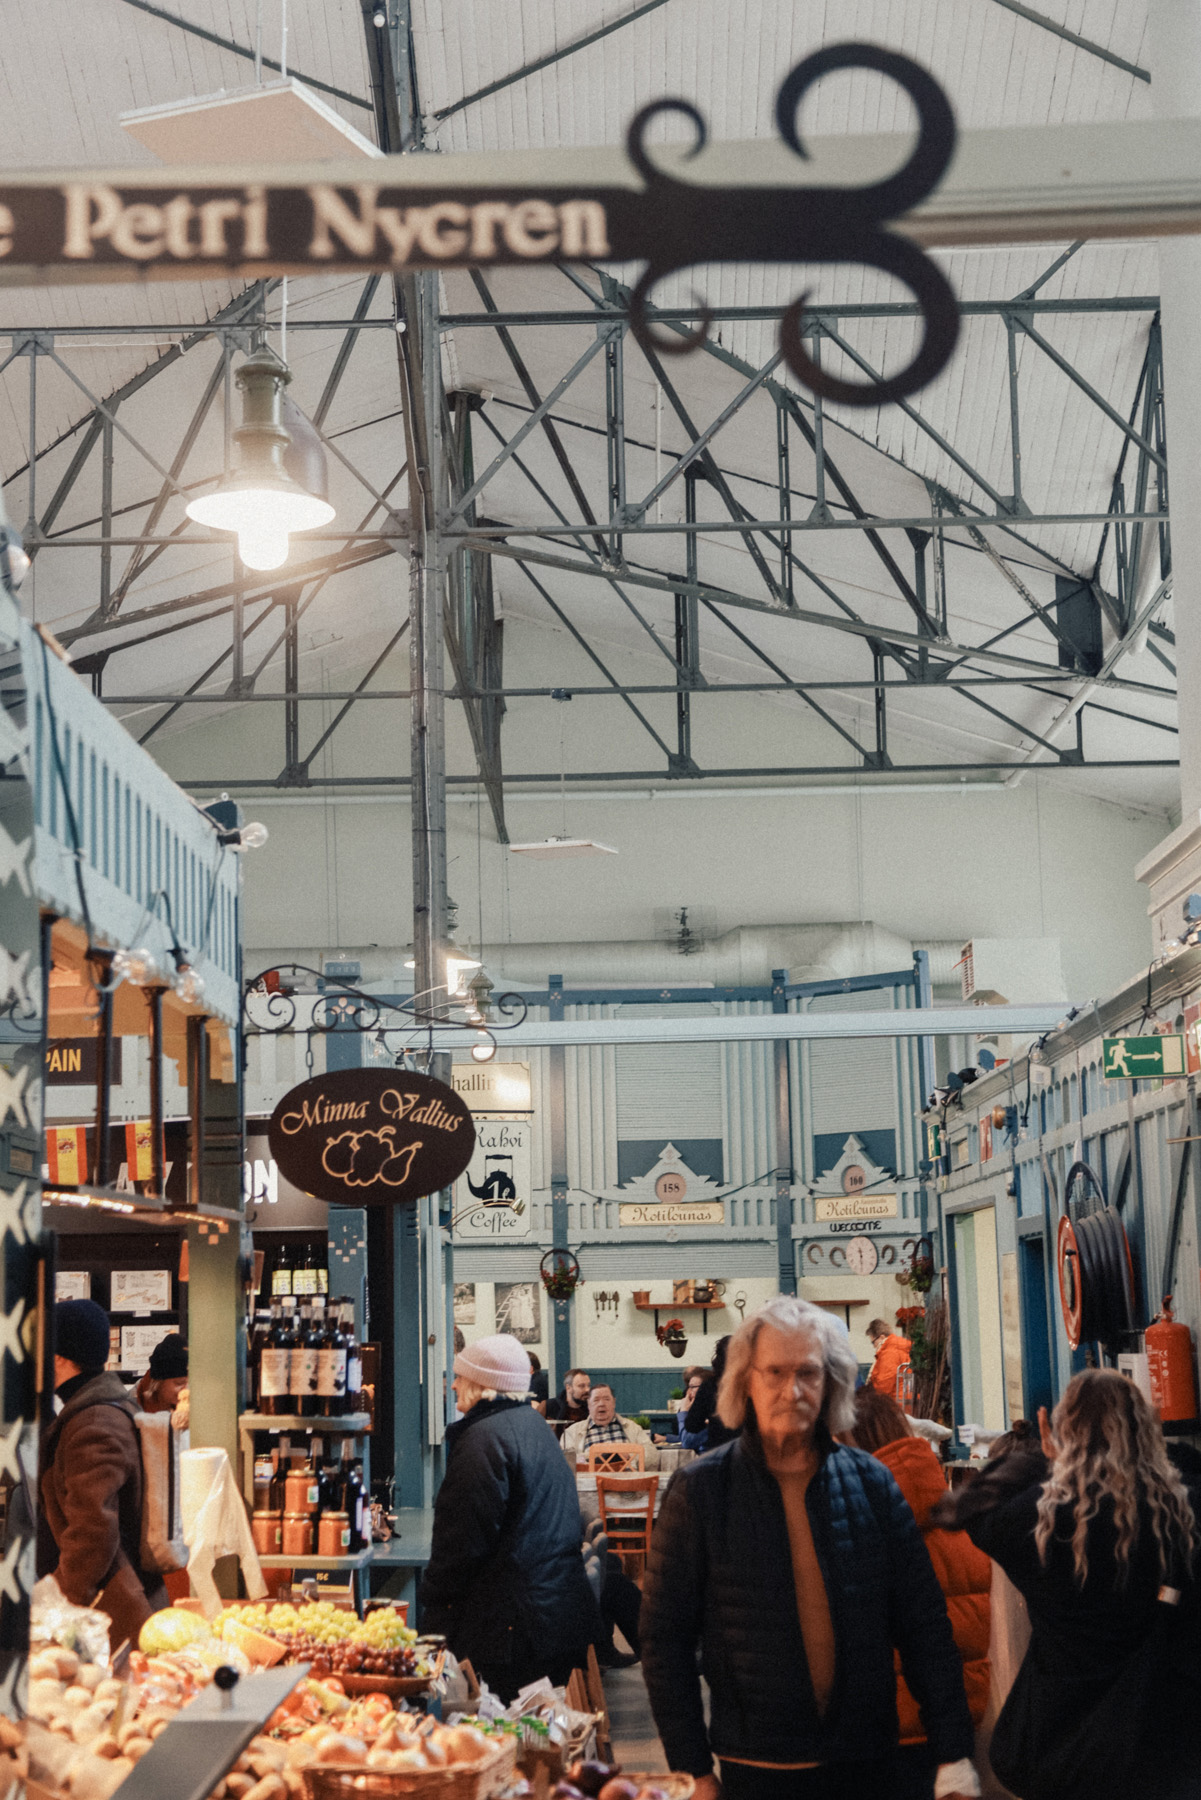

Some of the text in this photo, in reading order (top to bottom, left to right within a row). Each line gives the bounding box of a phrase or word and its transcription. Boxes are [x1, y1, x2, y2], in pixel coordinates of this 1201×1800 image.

[61, 184, 270, 260] Petri
[46, 1049, 81, 1072] AIN
[281, 1089, 463, 1134] Minna Vallius
[663, 1183, 680, 1193] 158
[850, 1176, 864, 1187] 160
[632, 1206, 712, 1222] Kotilounas
[826, 1200, 889, 1217] Kotilounas
[470, 1211, 517, 1233] Coffee
